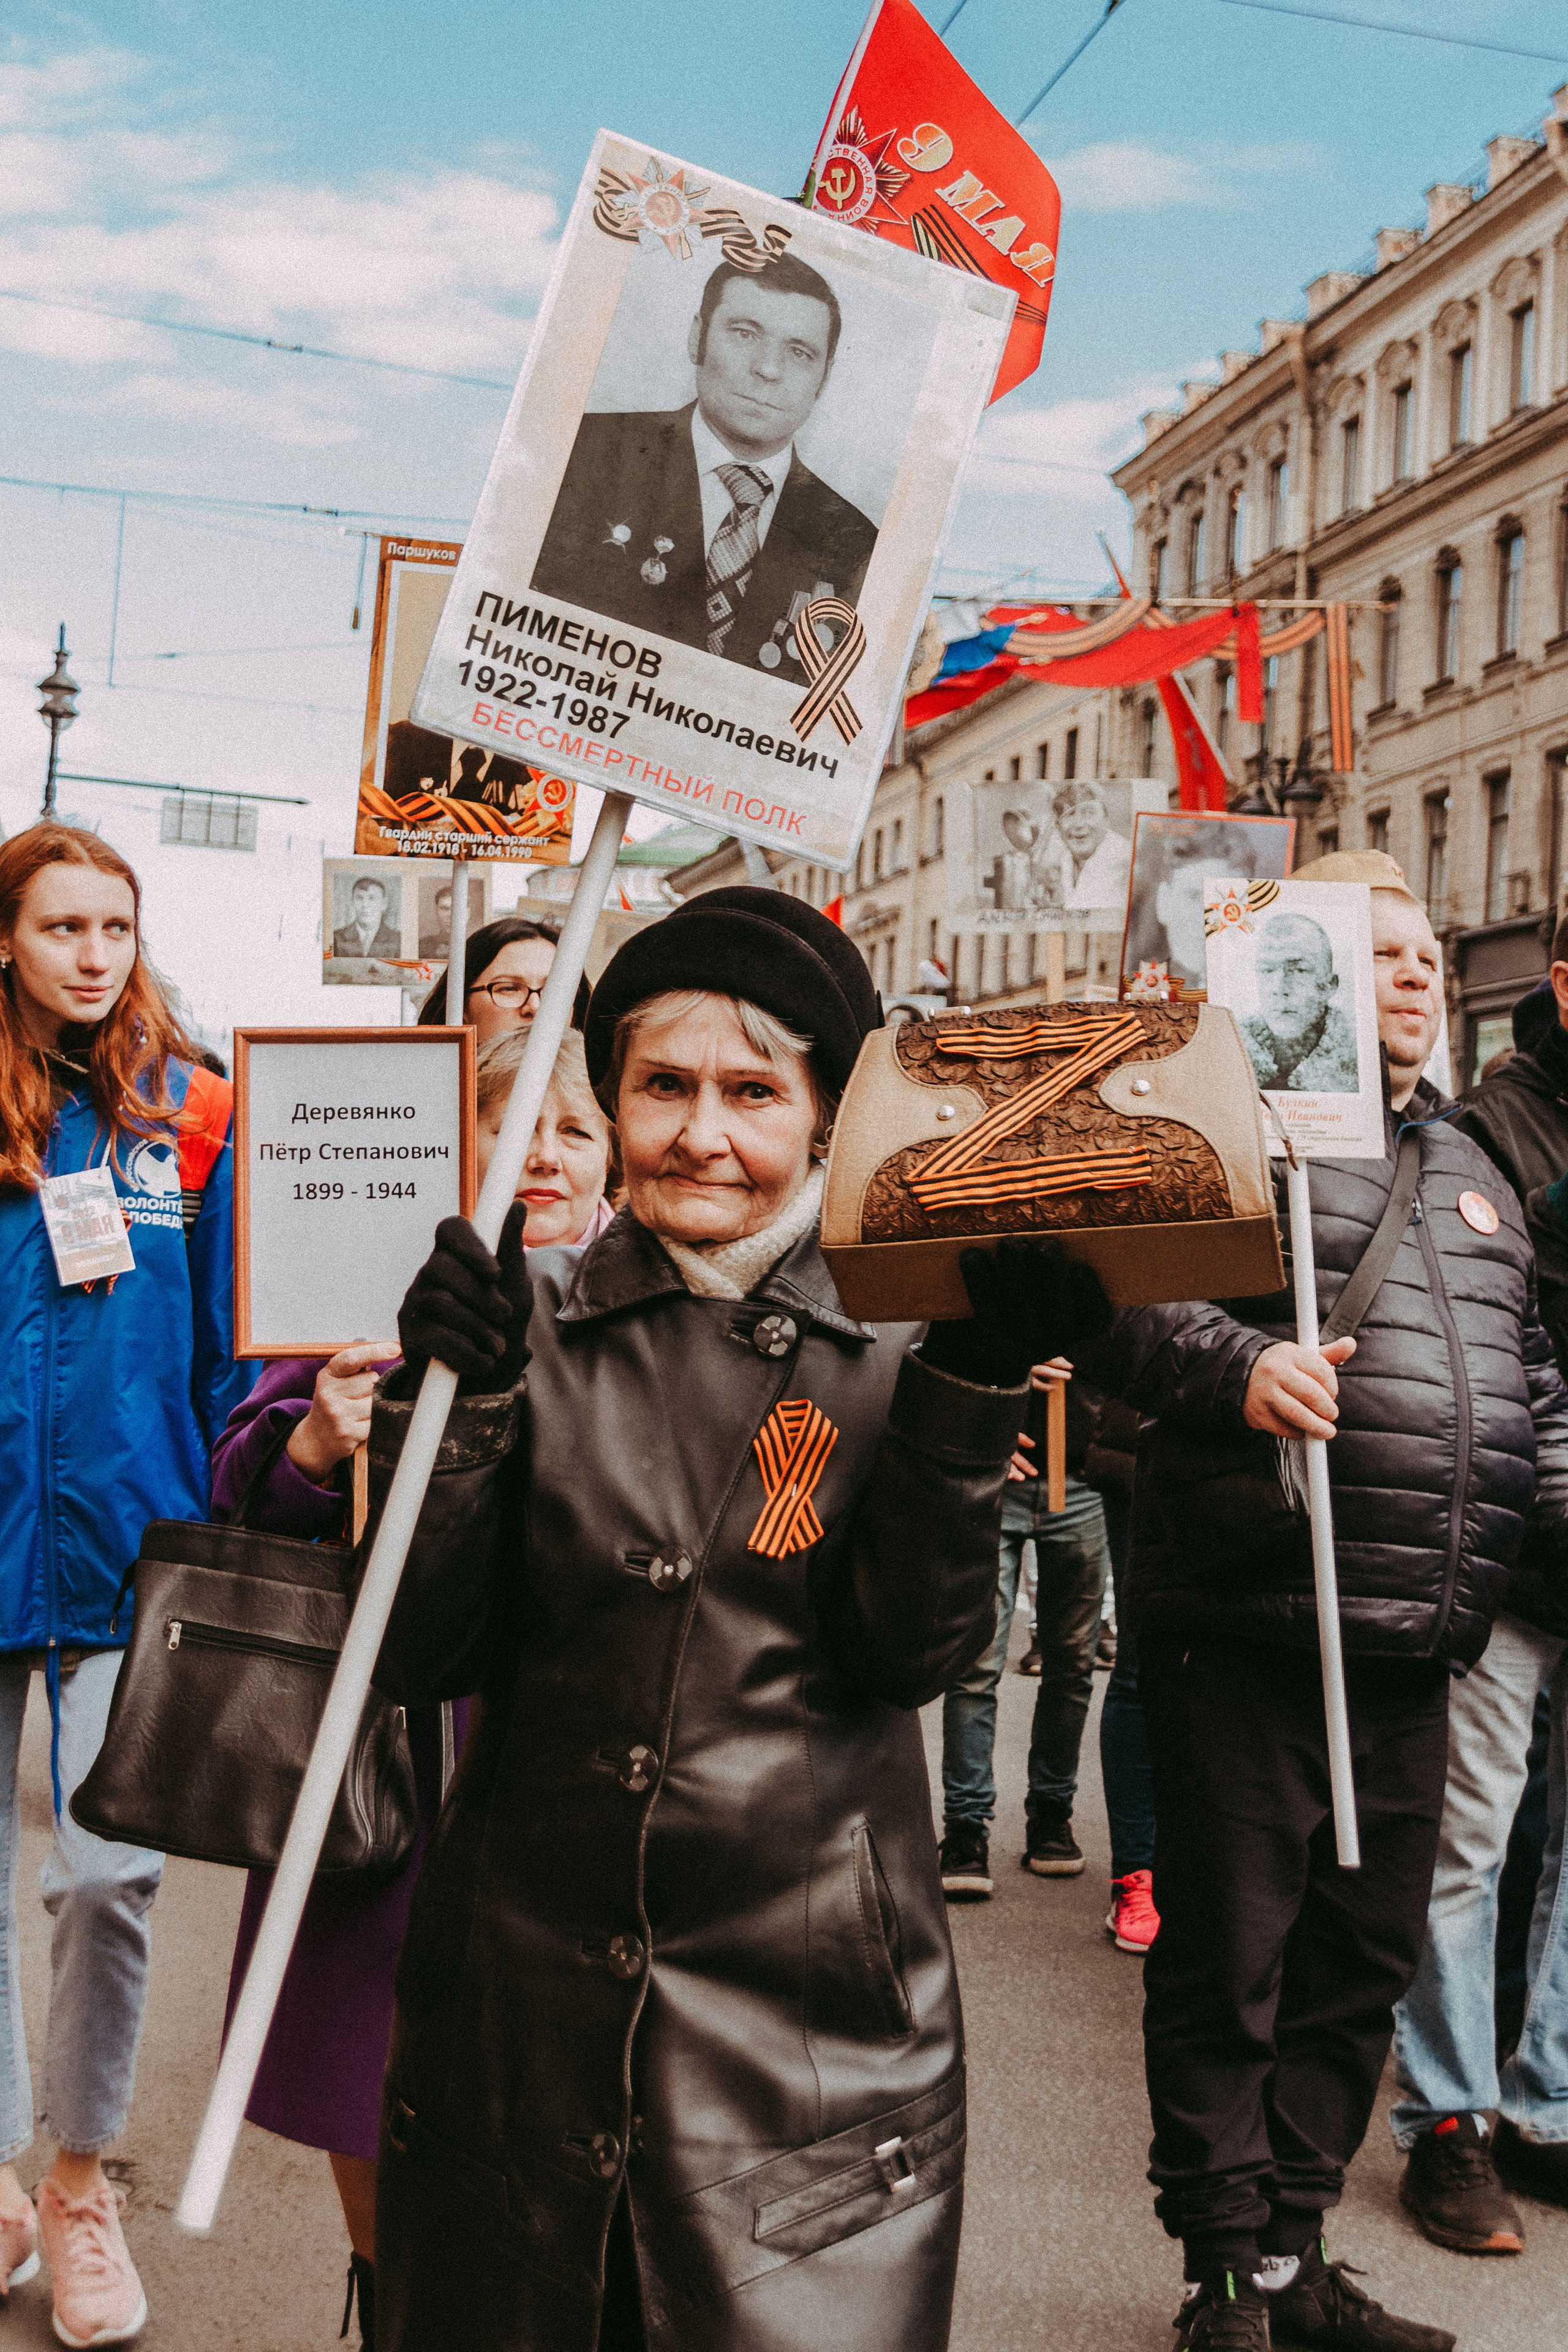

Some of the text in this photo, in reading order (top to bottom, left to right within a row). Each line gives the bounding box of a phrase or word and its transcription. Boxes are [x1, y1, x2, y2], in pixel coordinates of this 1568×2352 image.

[897, 123, 1055, 288] 9 МАЯ
[387, 541, 456, 560] Паршуков
[475, 590, 662, 678] ПИМЕНОВ
[459, 660, 630, 739] 1922-1987
[465, 624, 839, 778] Николай Николаевич
[472, 702, 807, 835] БЕССМЕРТНЫЙ ПОЛК
[379, 826, 550, 847] Гвардии старший сержант
[397, 840, 459, 855] 18.02.1918
[471, 844, 532, 858] 16.04.1990
[292, 1103, 416, 1124] Деревянко
[260, 1143, 449, 1164] Пётр Степанович
[293, 1183, 344, 1200] 1899
[366, 1182, 417, 1199] 1944
[75, 1215, 115, 1241] МАЯ
[129, 1210, 183, 1229] ПОБЕД
